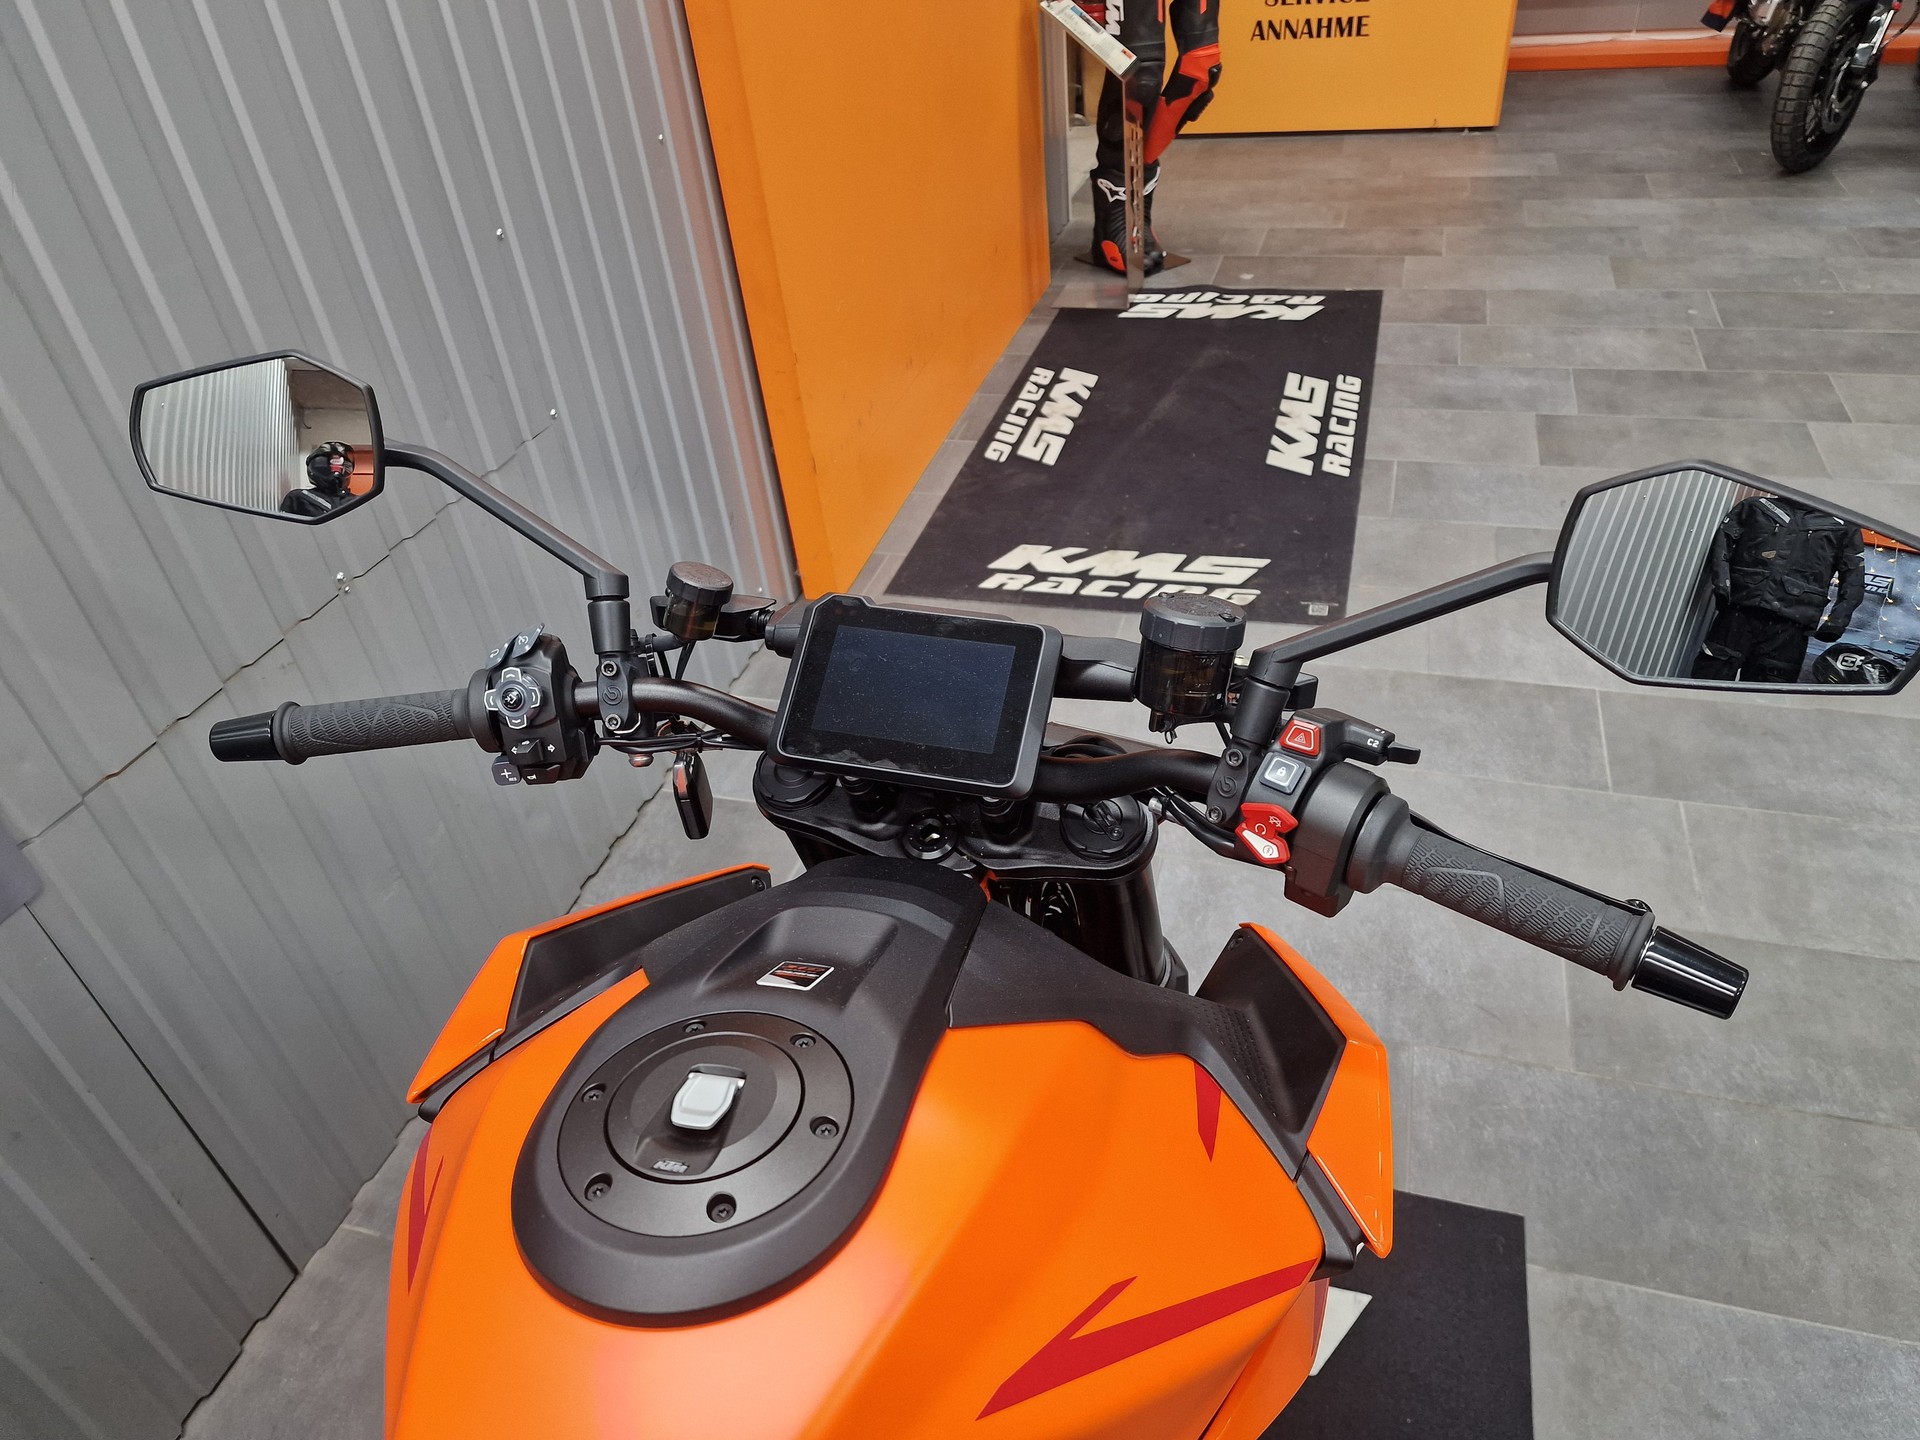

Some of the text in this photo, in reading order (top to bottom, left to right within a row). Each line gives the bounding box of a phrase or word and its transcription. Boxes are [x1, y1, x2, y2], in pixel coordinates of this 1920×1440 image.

[1250, 15, 1370, 41] ANNAHME
[1118, 303, 1325, 321] KMS
[984, 366, 1055, 463] RACING
[1017, 367, 1099, 466] KMS
[1265, 371, 1329, 476] KMS
[1321, 373, 1362, 477] RACING
[987, 544, 1272, 585] KMS
[1366, 738, 1380, 748] C2
